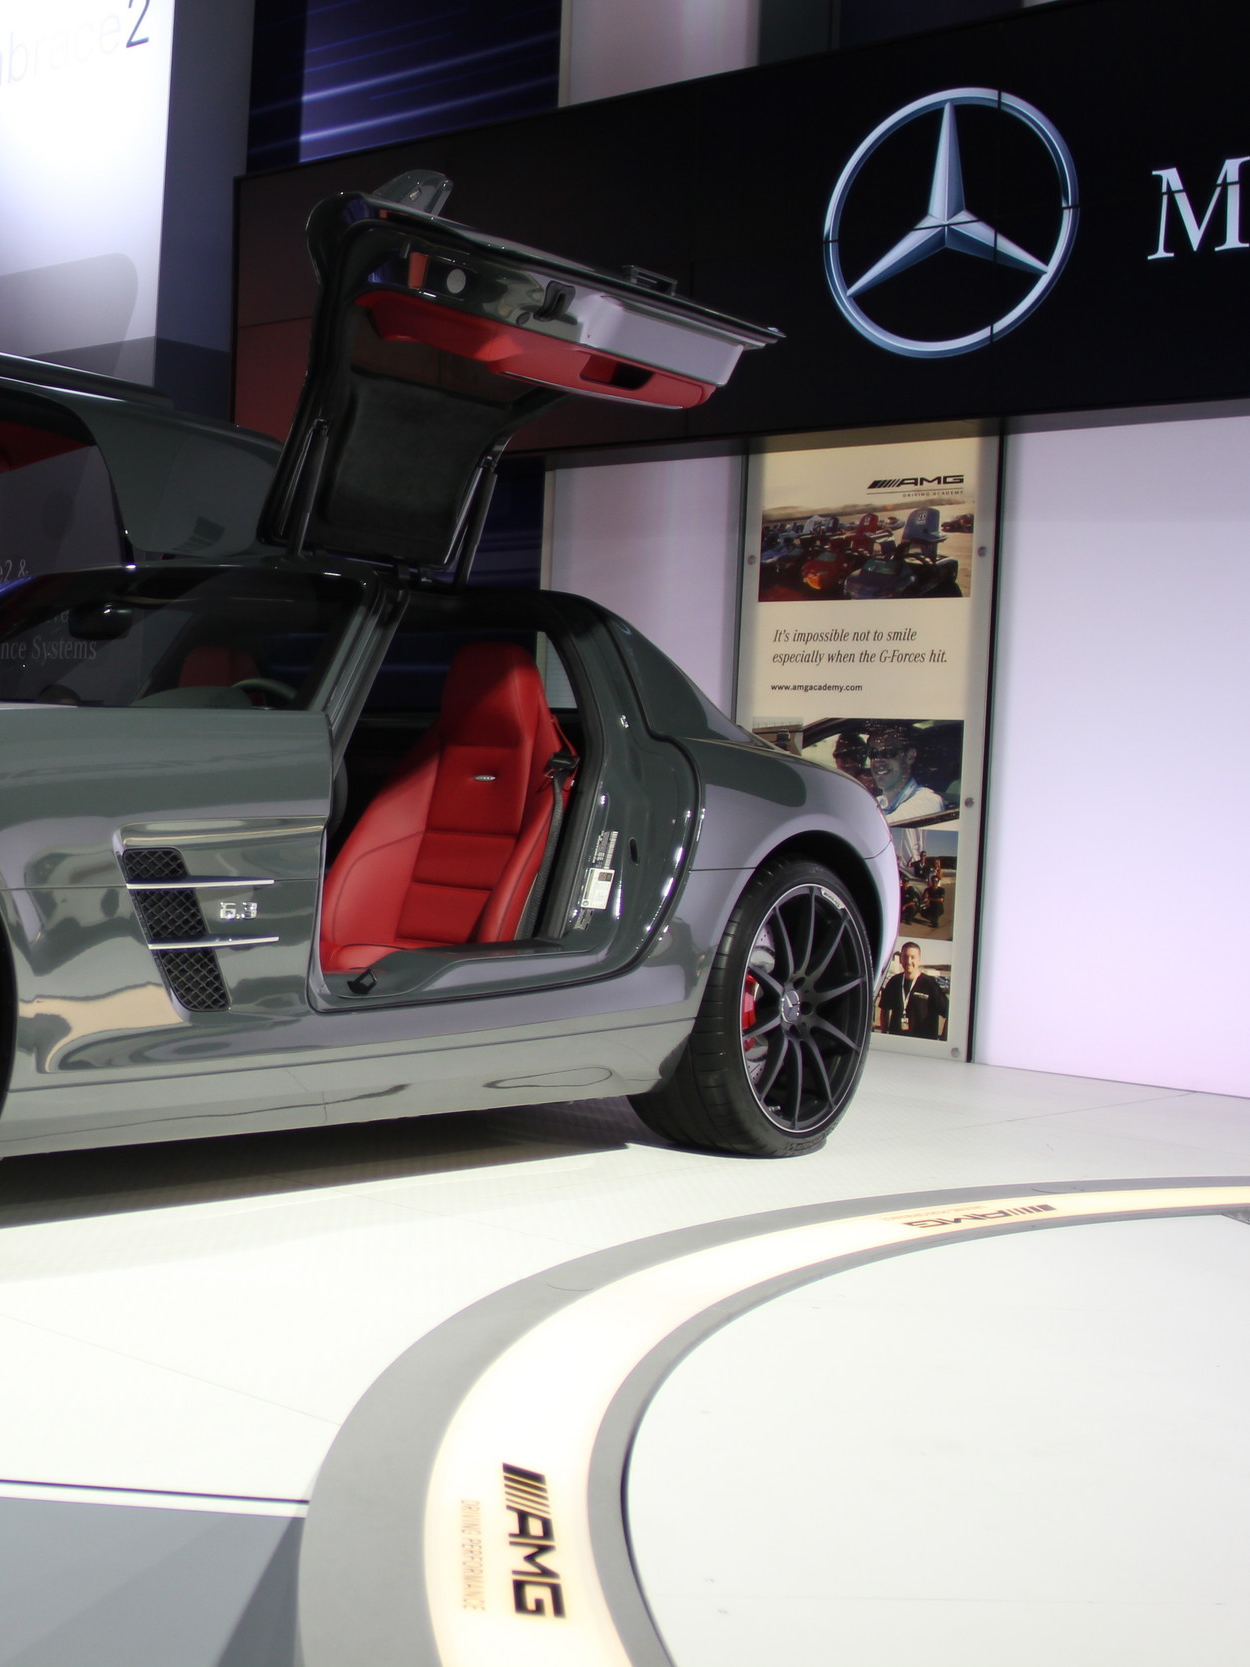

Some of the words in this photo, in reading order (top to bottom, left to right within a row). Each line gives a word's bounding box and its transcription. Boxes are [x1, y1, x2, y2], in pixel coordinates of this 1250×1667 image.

[896, 474, 965, 488] AMG
[773, 629, 790, 642] It's
[793, 628, 850, 645] impossible
[852, 629, 871, 642] not
[873, 629, 884, 642] to
[886, 627, 917, 642] smile
[33, 636, 97, 665] Systems
[772, 650, 825, 666] especially
[827, 650, 856, 663] when
[858, 649, 876, 663] the
[879, 649, 926, 663] G-Forces
[928, 649, 948, 663] hit.
[770, 683, 863, 693] www.amgacademy.com
[220, 902, 258, 920] 6.3
[505, 1504, 567, 1618] AMG
